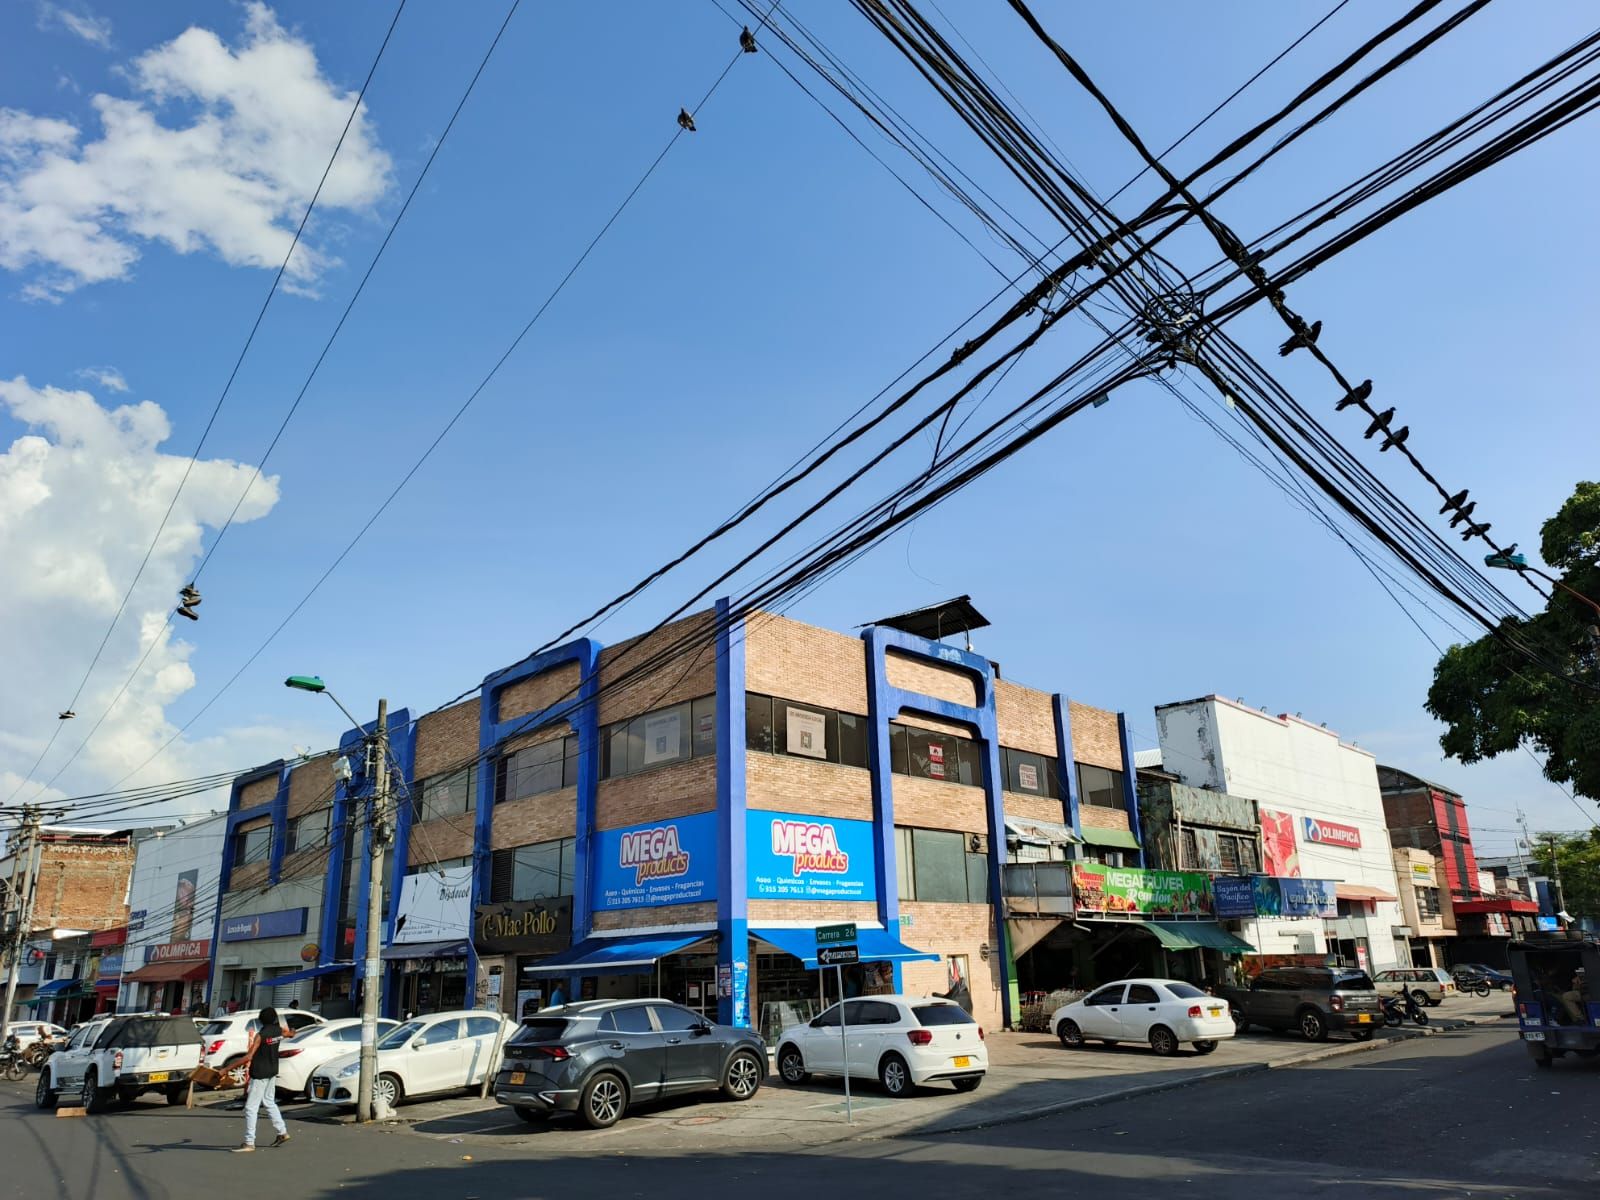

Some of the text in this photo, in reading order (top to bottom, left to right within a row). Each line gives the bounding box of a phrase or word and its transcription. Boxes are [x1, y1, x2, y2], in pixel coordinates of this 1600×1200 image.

[621, 828, 679, 865] MEGA
[772, 821, 838, 856] MEGA
[1321, 826, 1359, 844] OLIMPICA
[637, 855, 687, 885] products
[795, 852, 847, 875] products
[1106, 872, 1185, 891] MEGAFRUVER
[495, 910, 556, 937] Mac Pollo
[844, 927, 855, 937] 26
[159, 942, 201, 958] OLIMPICA
